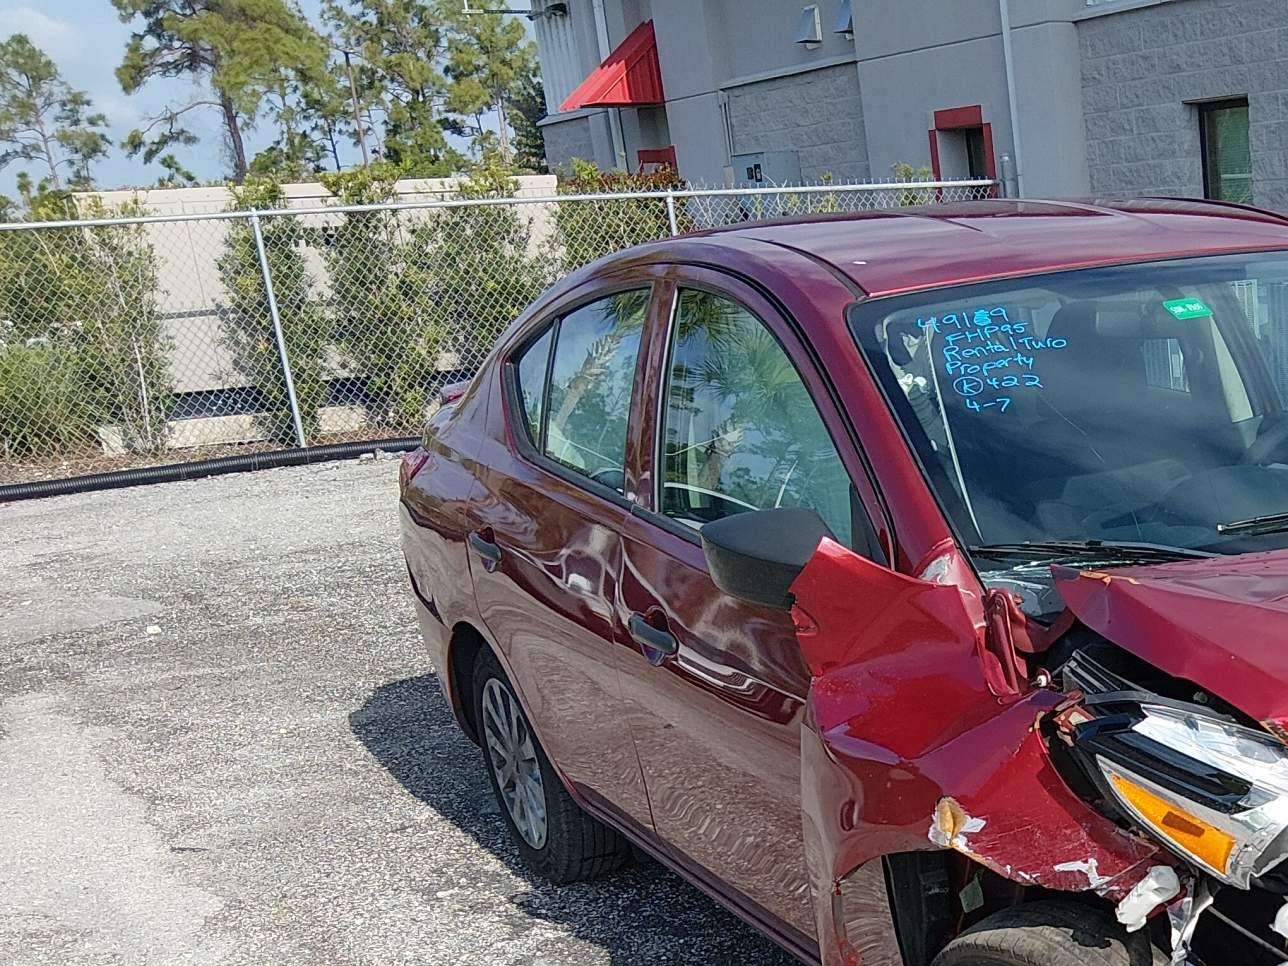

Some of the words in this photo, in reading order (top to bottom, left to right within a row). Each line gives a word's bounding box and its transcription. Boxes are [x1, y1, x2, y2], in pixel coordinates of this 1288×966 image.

[943, 336, 1018, 361] Rental
[1019, 336, 1068, 350] Turo
[945, 352, 1034, 376] Property
[986, 374, 1044, 390] 422
[965, 398, 1011, 413] 4-7
